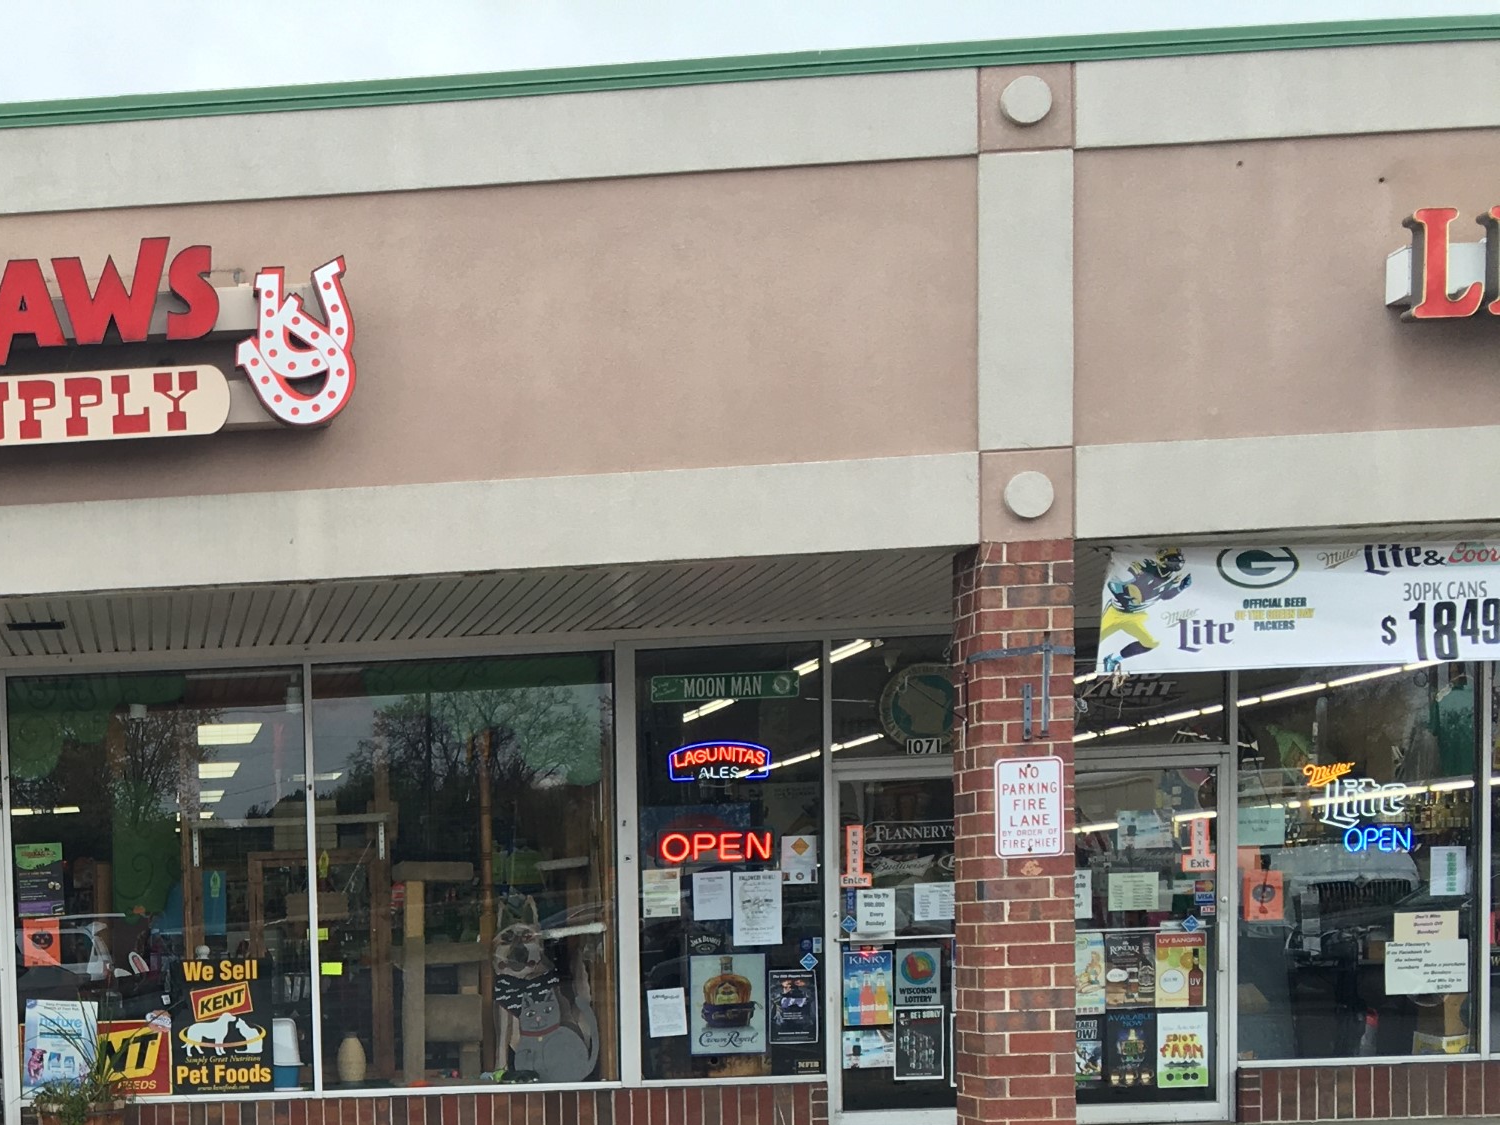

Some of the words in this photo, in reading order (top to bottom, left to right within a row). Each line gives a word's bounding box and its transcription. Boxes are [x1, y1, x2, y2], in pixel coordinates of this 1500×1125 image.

[1412, 206, 1500, 319] L
[1317, 548, 1363, 570] Miller
[1364, 543, 1422, 576] Lite
[1423, 549, 1446, 567] &
[1448, 542, 1500, 564] Coor
[1403, 582, 1443, 601] 30PK
[1447, 580, 1488, 600] CANS
[1243, 598, 1282, 609] OFFICIAL
[1284, 597, 1308, 608] BEER
[1161, 608, 1200, 628] Miller
[1234, 610, 1247, 621] OF
[1248, 610, 1265, 620] THE
[1267, 609, 1294, 620] GREEN
[1296, 608, 1316, 619] BAY
[1253, 620, 1296, 632] PACKERS
[1177, 618, 1235, 653] Lite
[683, 677, 725, 698] MOON
[731, 675, 762, 696] MAN
[908, 739, 941, 754] 1071
[673, 746, 766, 768] LAGUNITAS
[699, 766, 740, 779] ALES
[1018, 766, 1040, 779] NO
[1303, 761, 1356, 787] Miller
[1002, 781, 1058, 796] PARKING
[1013, 797, 1047, 811] FIRE
[1319, 777, 1408, 829] Lite
[1010, 813, 1051, 828] LANE
[1016, 829, 1043, 837] ORDER
[1048, 827, 1058, 835] OF
[1343, 827, 1412, 852] OPEN
[661, 831, 773, 863] OPEN
[1002, 838, 1026, 849] FIRE
[1027, 837, 1058, 848] CHIEF
[1190, 858, 1211, 868] Exit
[842, 875, 868, 885] Enter
[849, 955, 887, 965] KINKY
[183, 961, 214, 982] We
[219, 959, 258, 981] Sell
[1190, 977, 1201, 986] UV
[899, 986, 937, 995] WISCONSIN
[200, 987, 245, 1016] KENT
[904, 994, 933, 1003] LOTTERY
[910, 1011, 920, 1019] GET
[1108, 1013, 1154, 1022] AVAILABLE
[1123, 1020, 1143, 1028] NOW
[699, 1030, 729, 1048] Crown
[721, 1030, 759, 1048] Royal
[1076, 1029, 1097, 1040] OW!
[105, 1032, 159, 1073] NT
[176, 1065, 209, 1085] Pet
[214, 1063, 272, 1084] Foods
